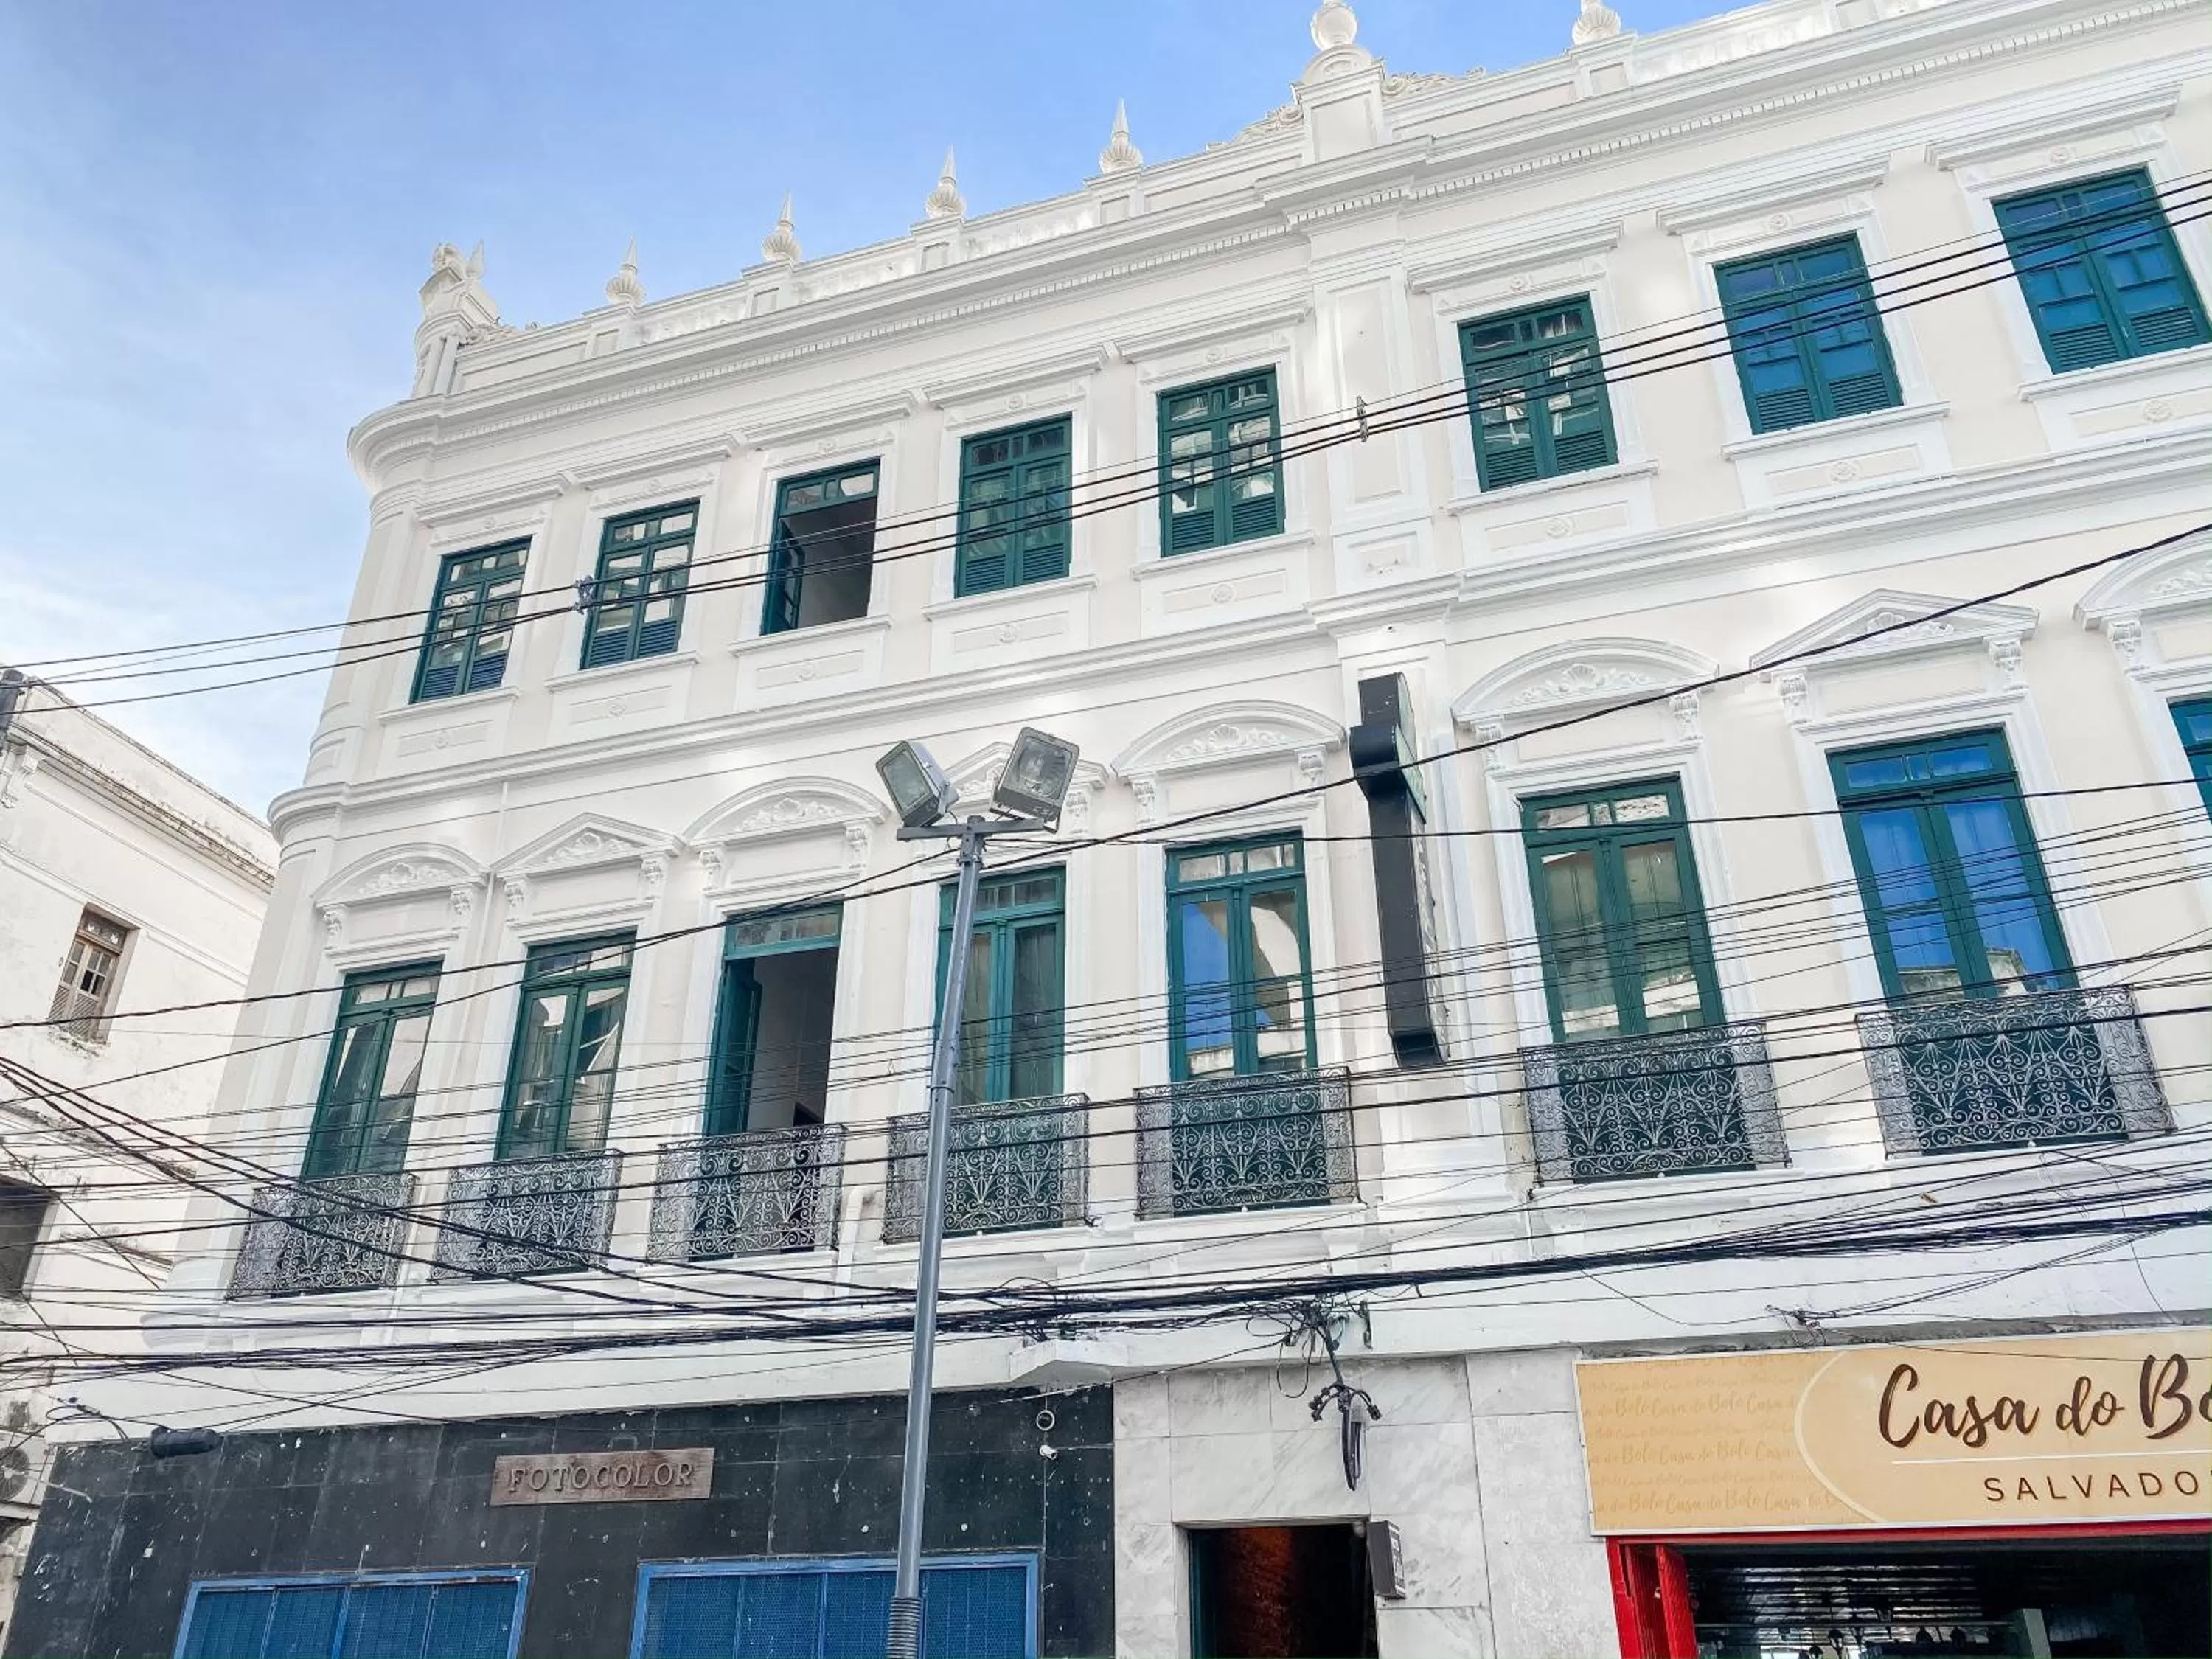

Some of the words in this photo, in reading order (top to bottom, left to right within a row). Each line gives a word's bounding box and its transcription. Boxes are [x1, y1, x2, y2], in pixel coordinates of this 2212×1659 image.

[1879, 1363, 2040, 1448] Casa
[2056, 1376, 2125, 1436] do
[507, 1462, 695, 1493] FOTOCOLOR
[1983, 1470, 2212, 1502] SALVADO
